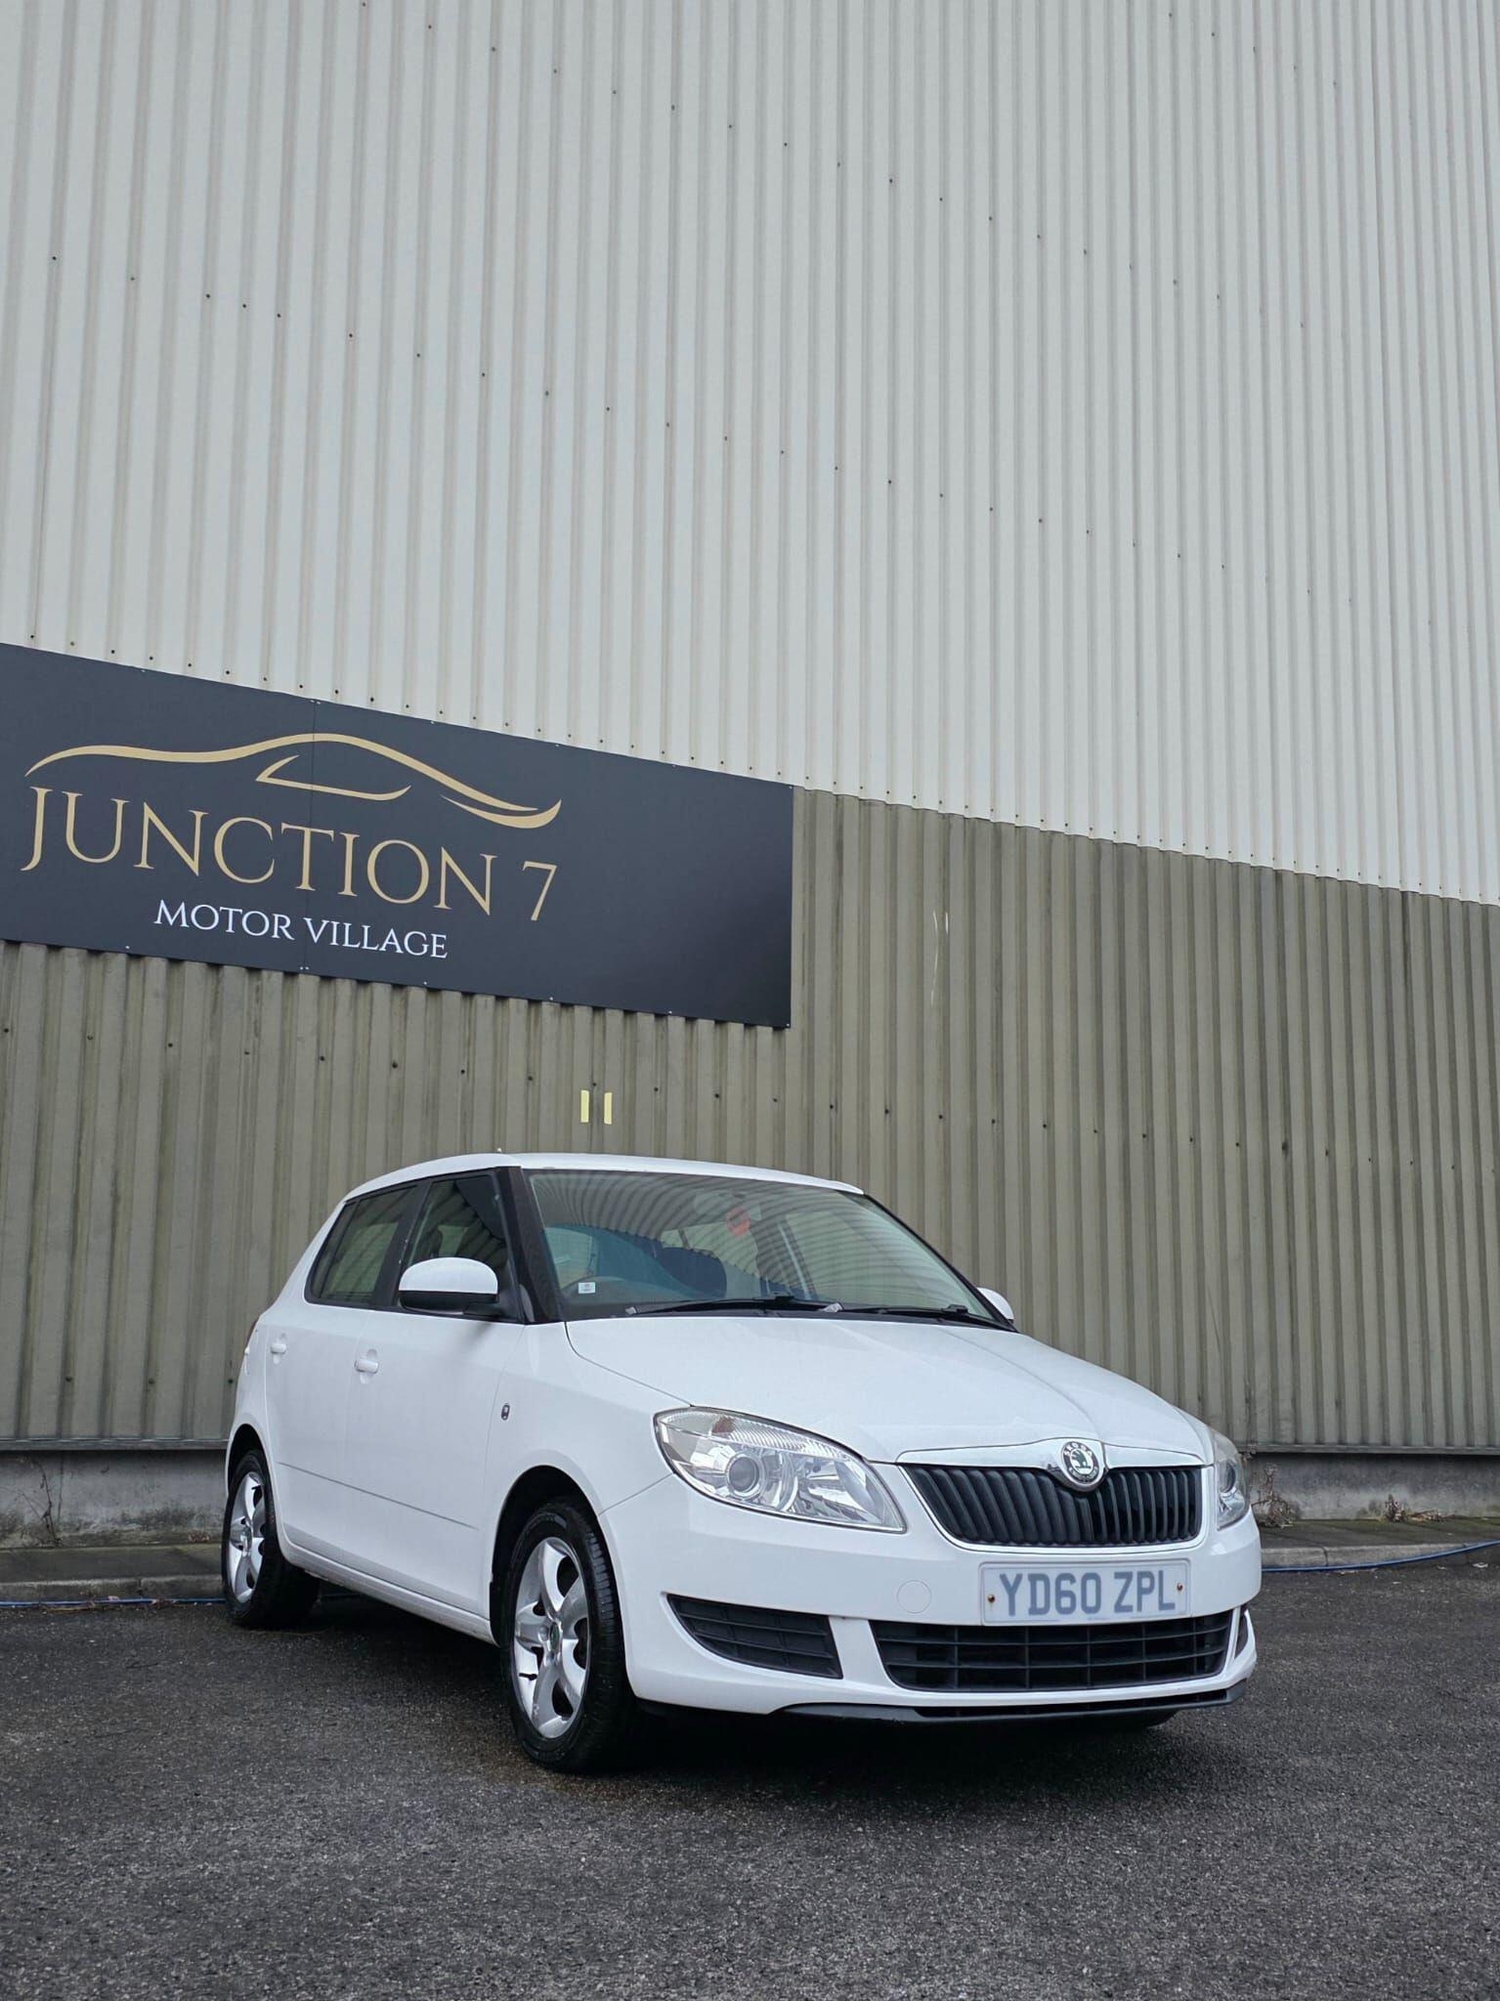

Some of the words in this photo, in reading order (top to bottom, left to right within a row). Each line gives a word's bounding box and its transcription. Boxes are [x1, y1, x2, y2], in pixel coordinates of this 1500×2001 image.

[20, 786, 498, 916] JUNCTION
[522, 861, 558, 921] 7
[154, 899, 295, 940] MOTOR
[304, 917, 448, 958] VILLAGE
[1000, 1572, 1101, 1616] YD60
[1113, 1570, 1176, 1613] ZPL
